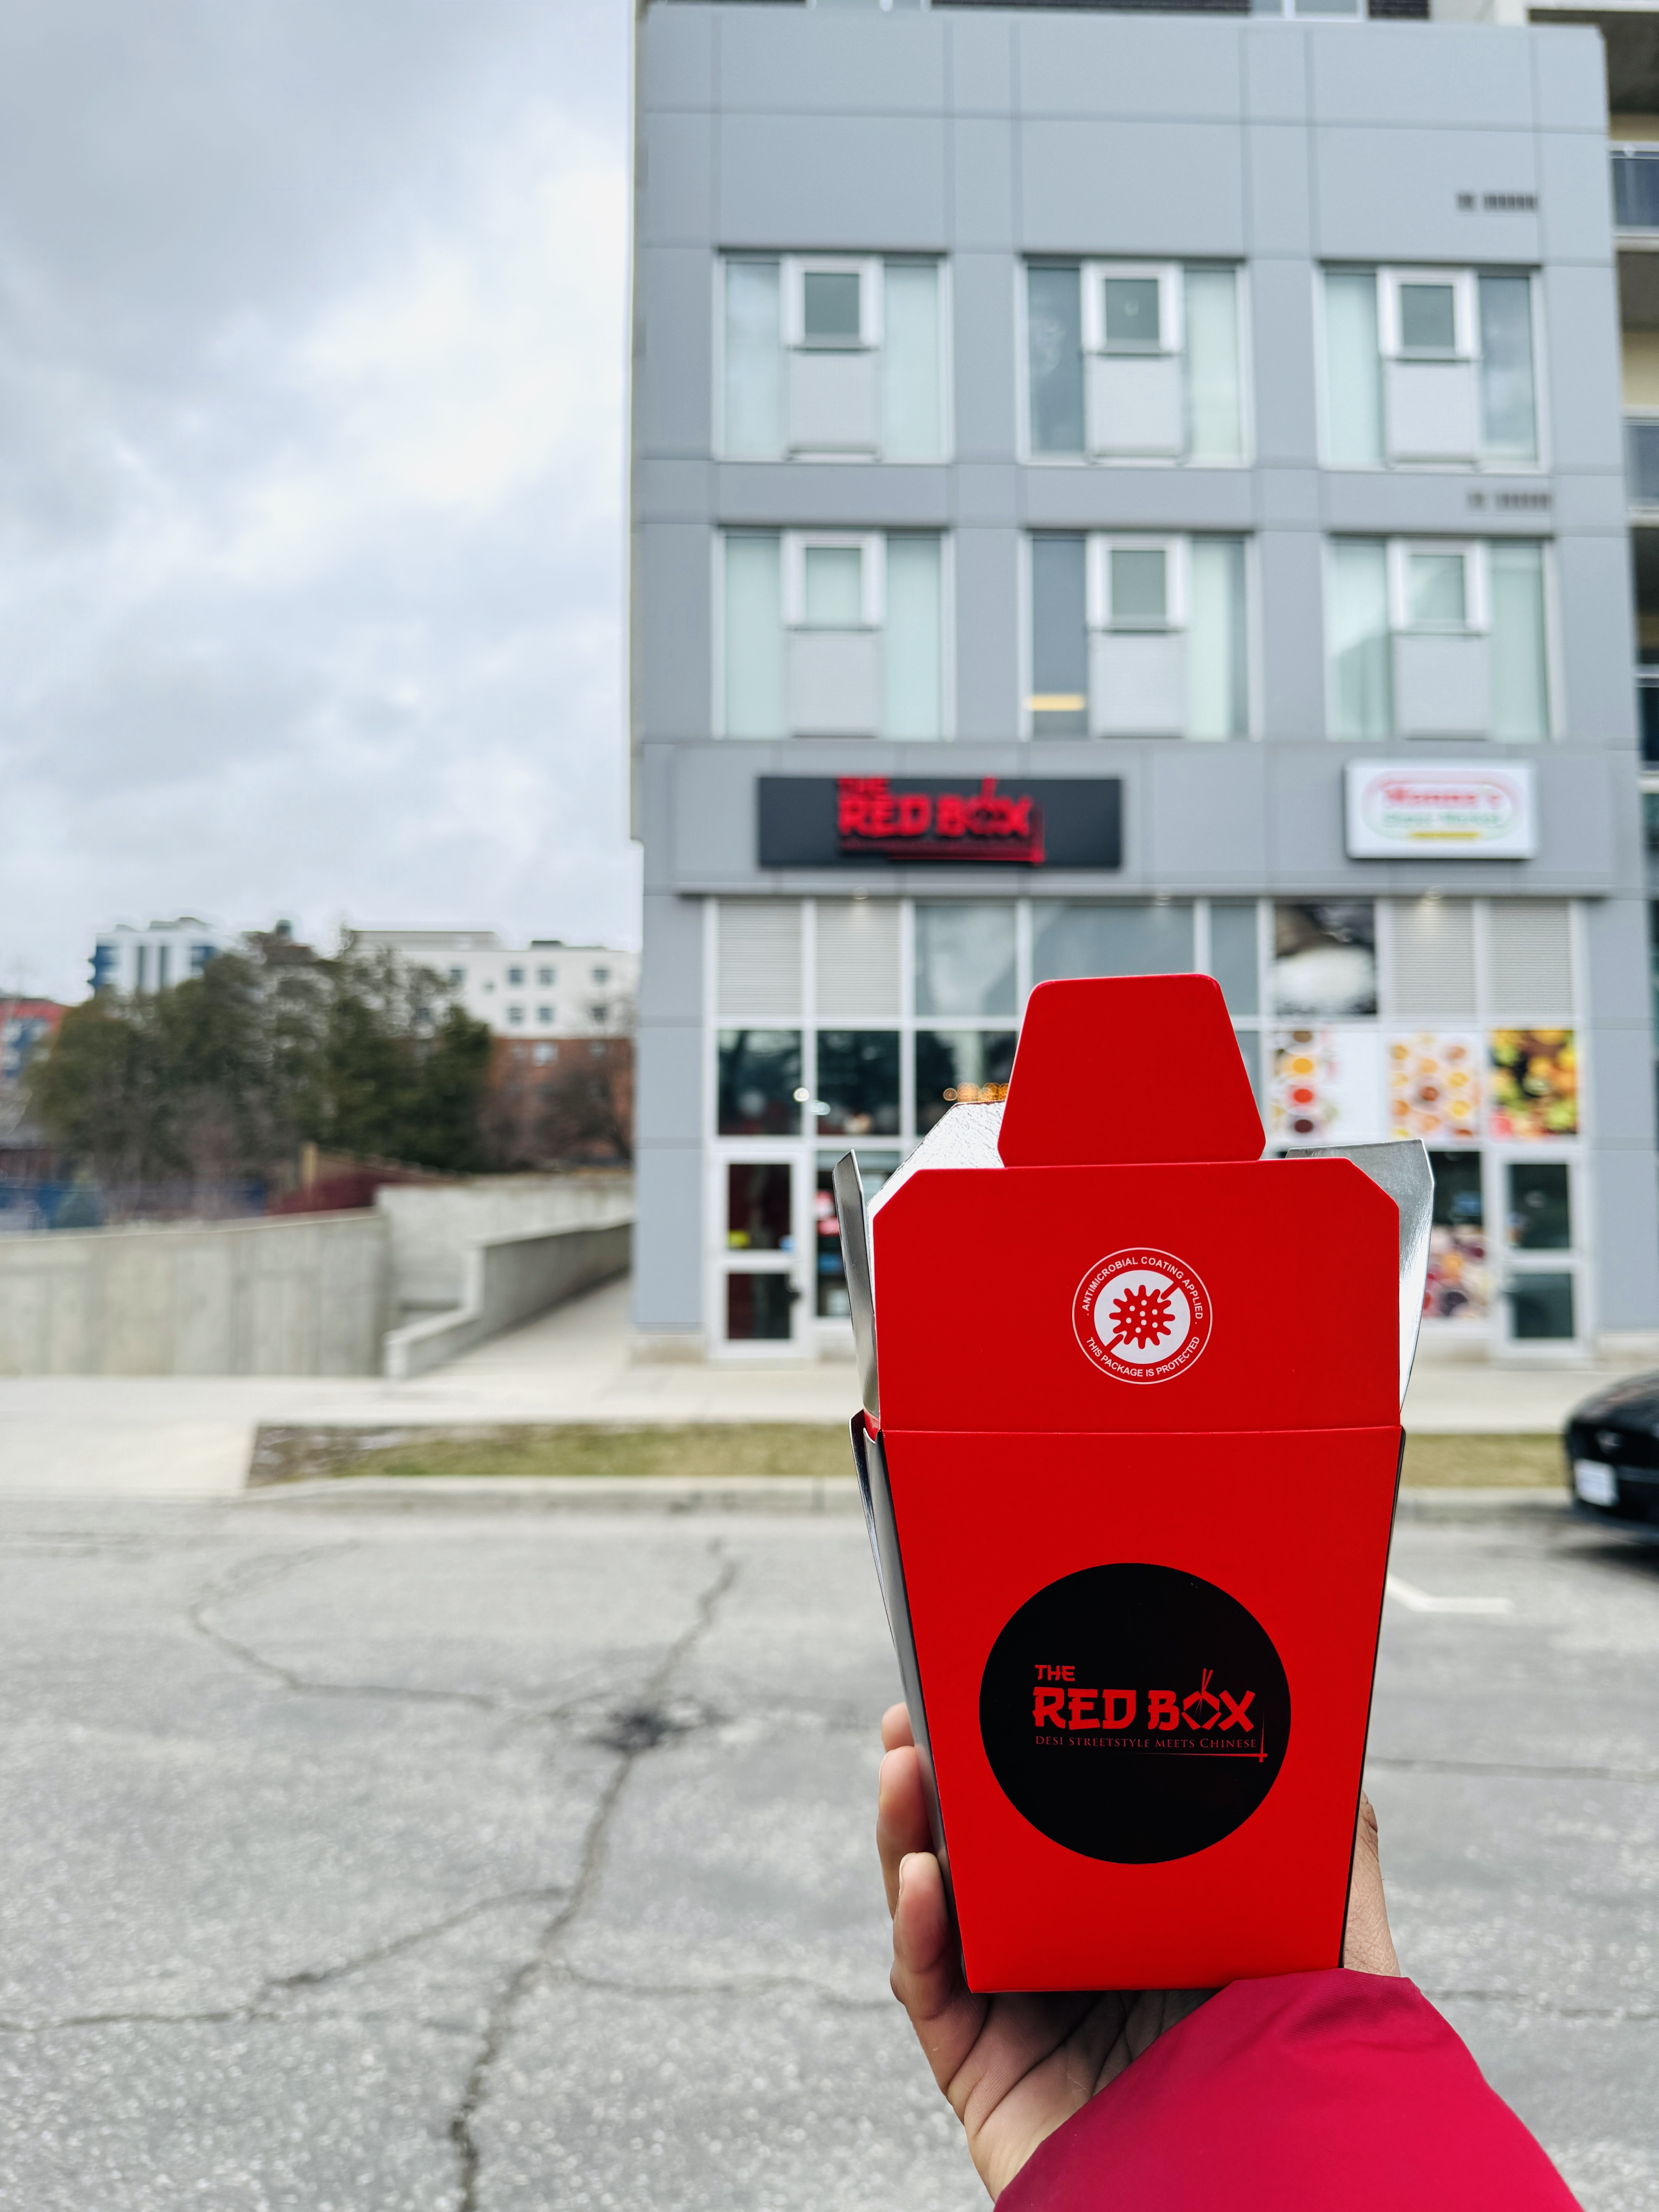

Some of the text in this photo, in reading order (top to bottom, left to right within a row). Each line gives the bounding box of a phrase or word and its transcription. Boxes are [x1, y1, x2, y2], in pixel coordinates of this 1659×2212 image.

[838, 794, 1033, 836] RED BOX
[1082, 1257, 1203, 1319] ANTIMICROBIAL COATING APPLIED
[1086, 1336, 1200, 1377] THIS PACKAGE IS PROTECTED
[1034, 1664, 1075, 1681] THE
[1032, 1686, 1255, 1732] RED BOX
[1036, 1736, 1257, 1748] DESI STREETSTYLE MEETS CHINESE
